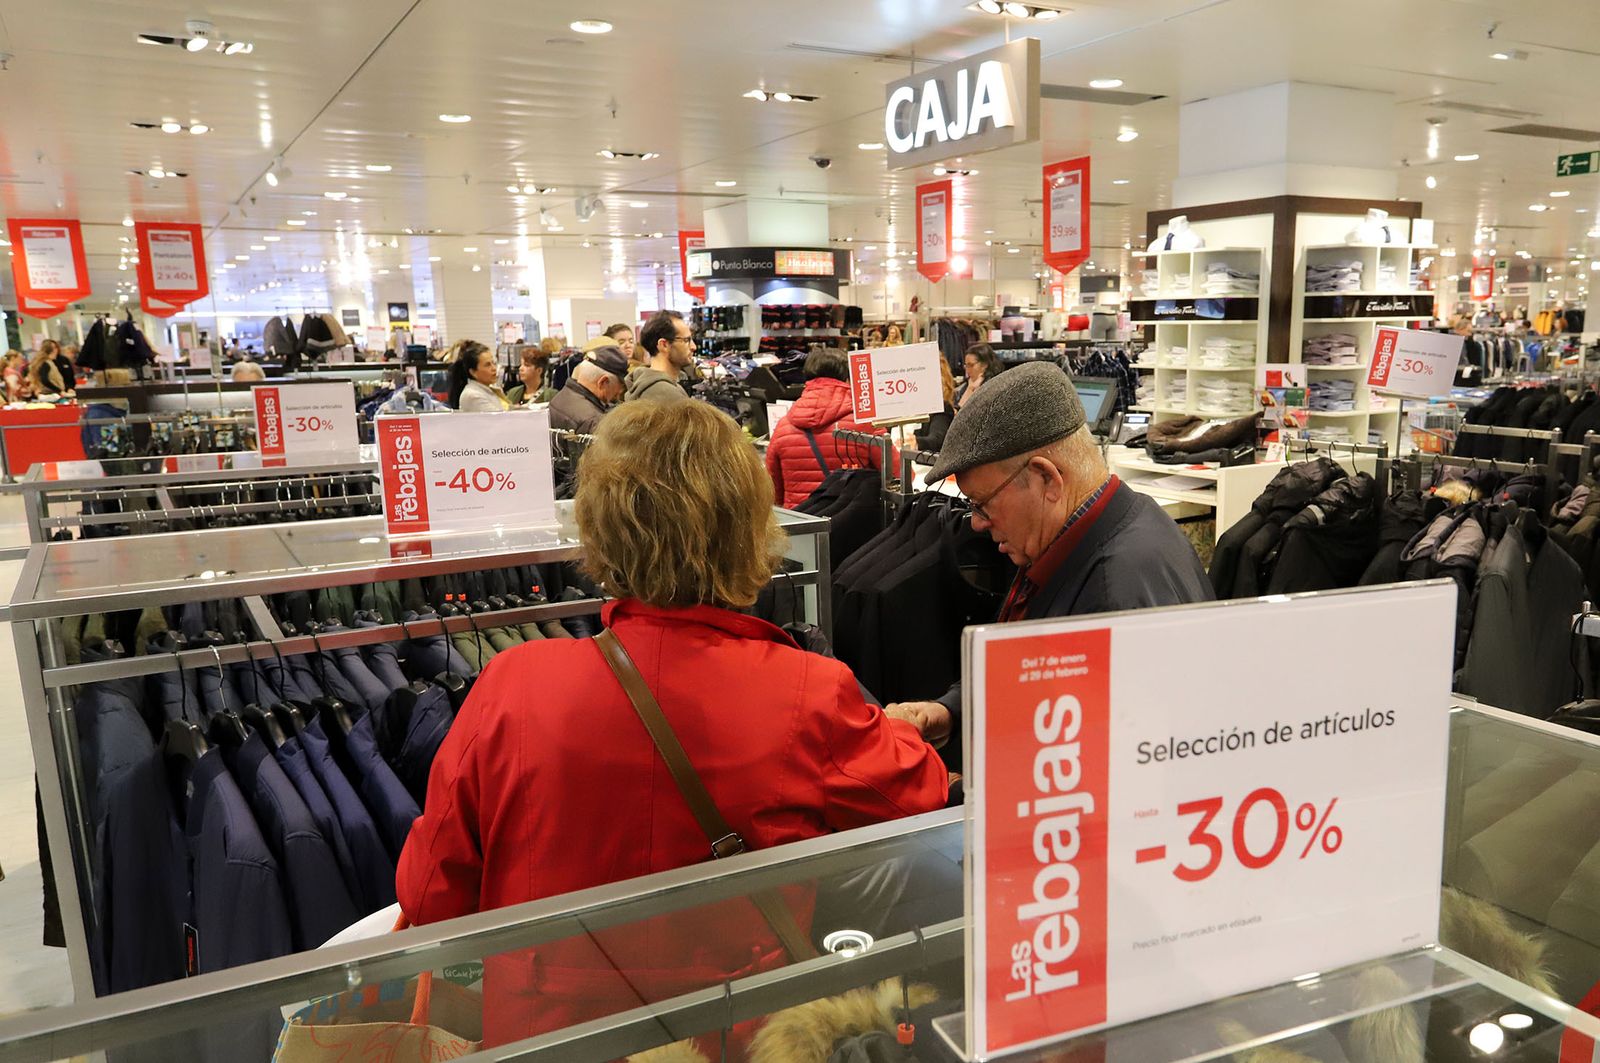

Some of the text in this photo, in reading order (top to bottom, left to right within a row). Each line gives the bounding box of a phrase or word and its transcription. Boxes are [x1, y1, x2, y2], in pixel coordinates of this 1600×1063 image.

[885, 60, 1014, 153] CAJA
[720, 259, 773, 270] Punto Blanco
[1375, 338, 1393, 381] rebajas
[1395, 358, 1434, 376] -30%
[857, 363, 871, 412] rebajas
[878, 379, 918, 396] -30%
[262, 397, 280, 448] rebajas
[287, 416, 334, 432] -30%
[431, 445, 530, 459] Selección de artículos
[392, 435, 420, 522] rebajas
[434, 466, 517, 494] -40%
[1021, 656, 1038, 670] Del
[1046, 654, 1059, 667] de
[1060, 653, 1087, 664] enero
[1042, 668, 1055, 680] de
[1056, 666, 1089, 678] febrero
[1136, 706, 1396, 765] Selección de artículos
[1133, 807, 1160, 819] Hasta
[1017, 693, 1095, 995] rebajas
[1135, 786, 1343, 883] -30%
[1006, 940, 1033, 1002] Las
